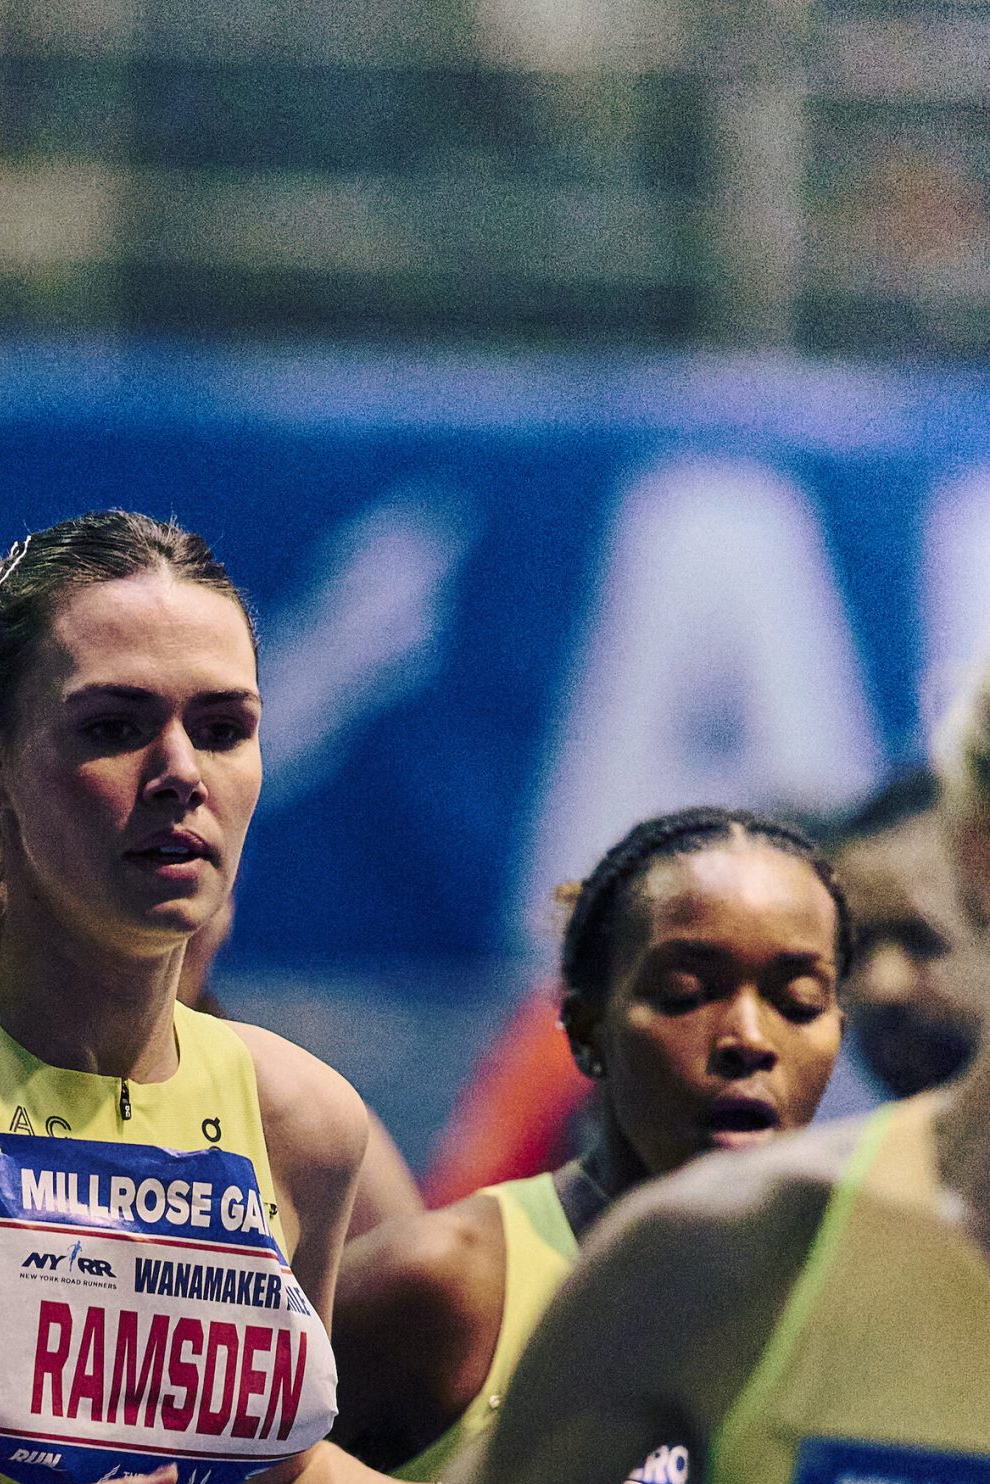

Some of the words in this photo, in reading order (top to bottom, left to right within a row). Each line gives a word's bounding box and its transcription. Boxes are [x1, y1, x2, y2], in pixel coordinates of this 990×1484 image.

[21, 1168, 212, 1228] MILLROSE
[221, 1184, 272, 1238] GA
[40, 1275, 59, 1283] YORK
[61, 1278, 81, 1286] ROAD
[83, 1280, 117, 1290] RUNNERS
[134, 1257, 281, 1310] WANAMAKER
[30, 1300, 307, 1440] RAMSDEN
[10, 1448, 62, 1468] RUN
